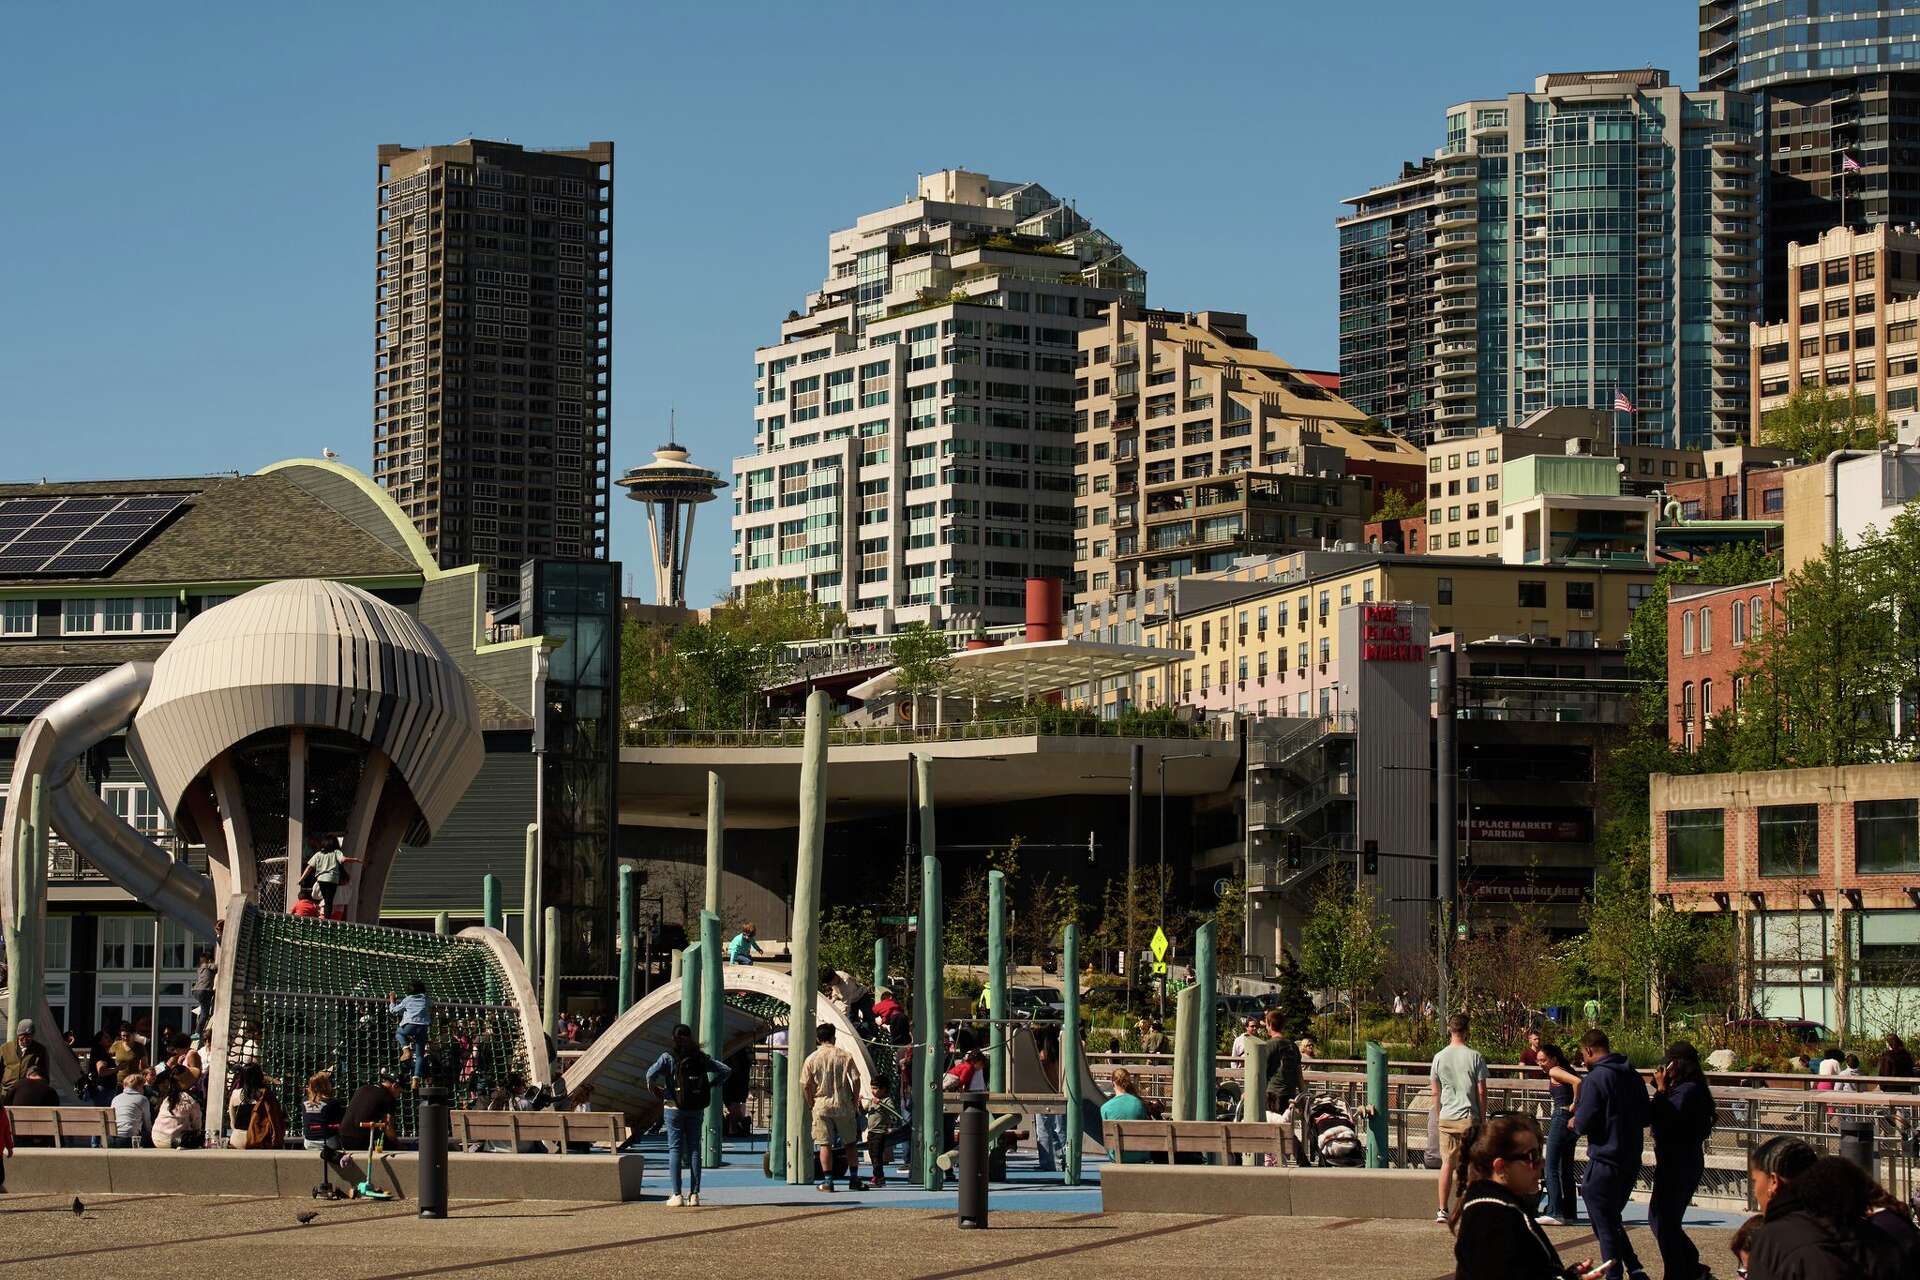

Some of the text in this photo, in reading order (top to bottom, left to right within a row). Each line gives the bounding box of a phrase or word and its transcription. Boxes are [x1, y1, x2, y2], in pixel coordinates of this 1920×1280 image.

[1364, 606, 1396, 622] PIKE
[1363, 625, 1411, 641] PLACE
[1363, 643, 1425, 661] MARKET
[1479, 820, 1510, 829] PLACE
[1512, 821, 1553, 830] MARKET
[1482, 830, 1525, 838] PARKING
[1479, 886, 1580, 896] ENTER GARAGE HERE
